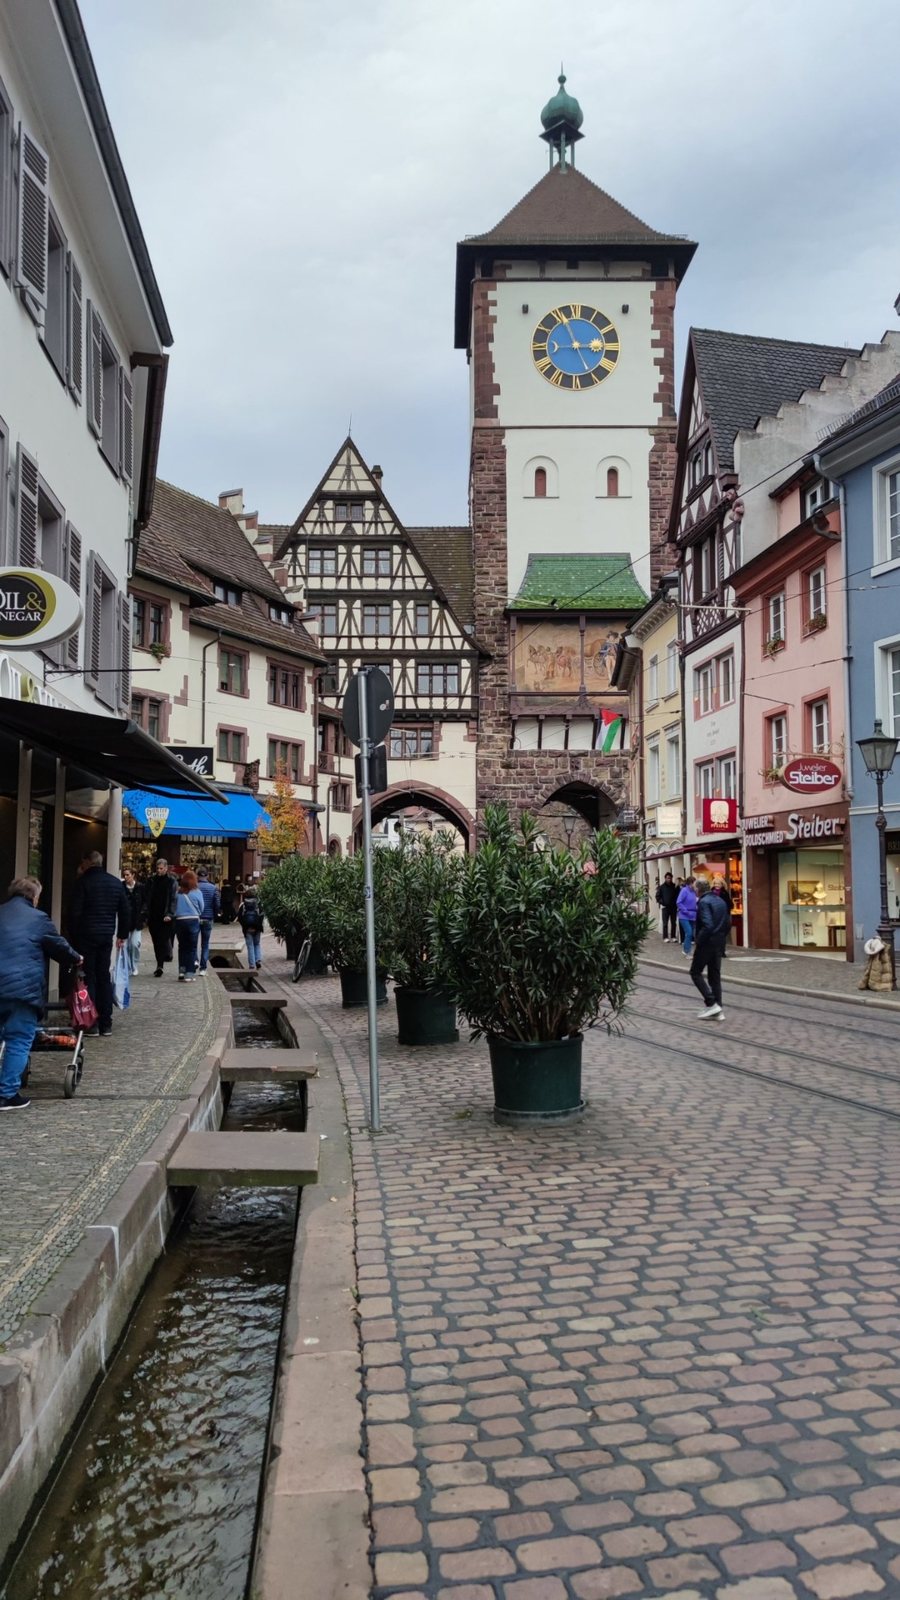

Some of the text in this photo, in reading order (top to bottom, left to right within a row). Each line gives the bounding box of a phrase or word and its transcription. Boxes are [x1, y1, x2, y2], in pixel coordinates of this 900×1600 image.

[570, 304, 581, 319] XII
[601, 323, 614, 334] II
[604, 342, 619, 351] III
[789, 771, 839, 784] Steiber
[740, 815, 769, 831] JUWELIER
[786, 813, 840, 840] Steiber
[745, 831, 784, 847] GOLDSCHMIED
